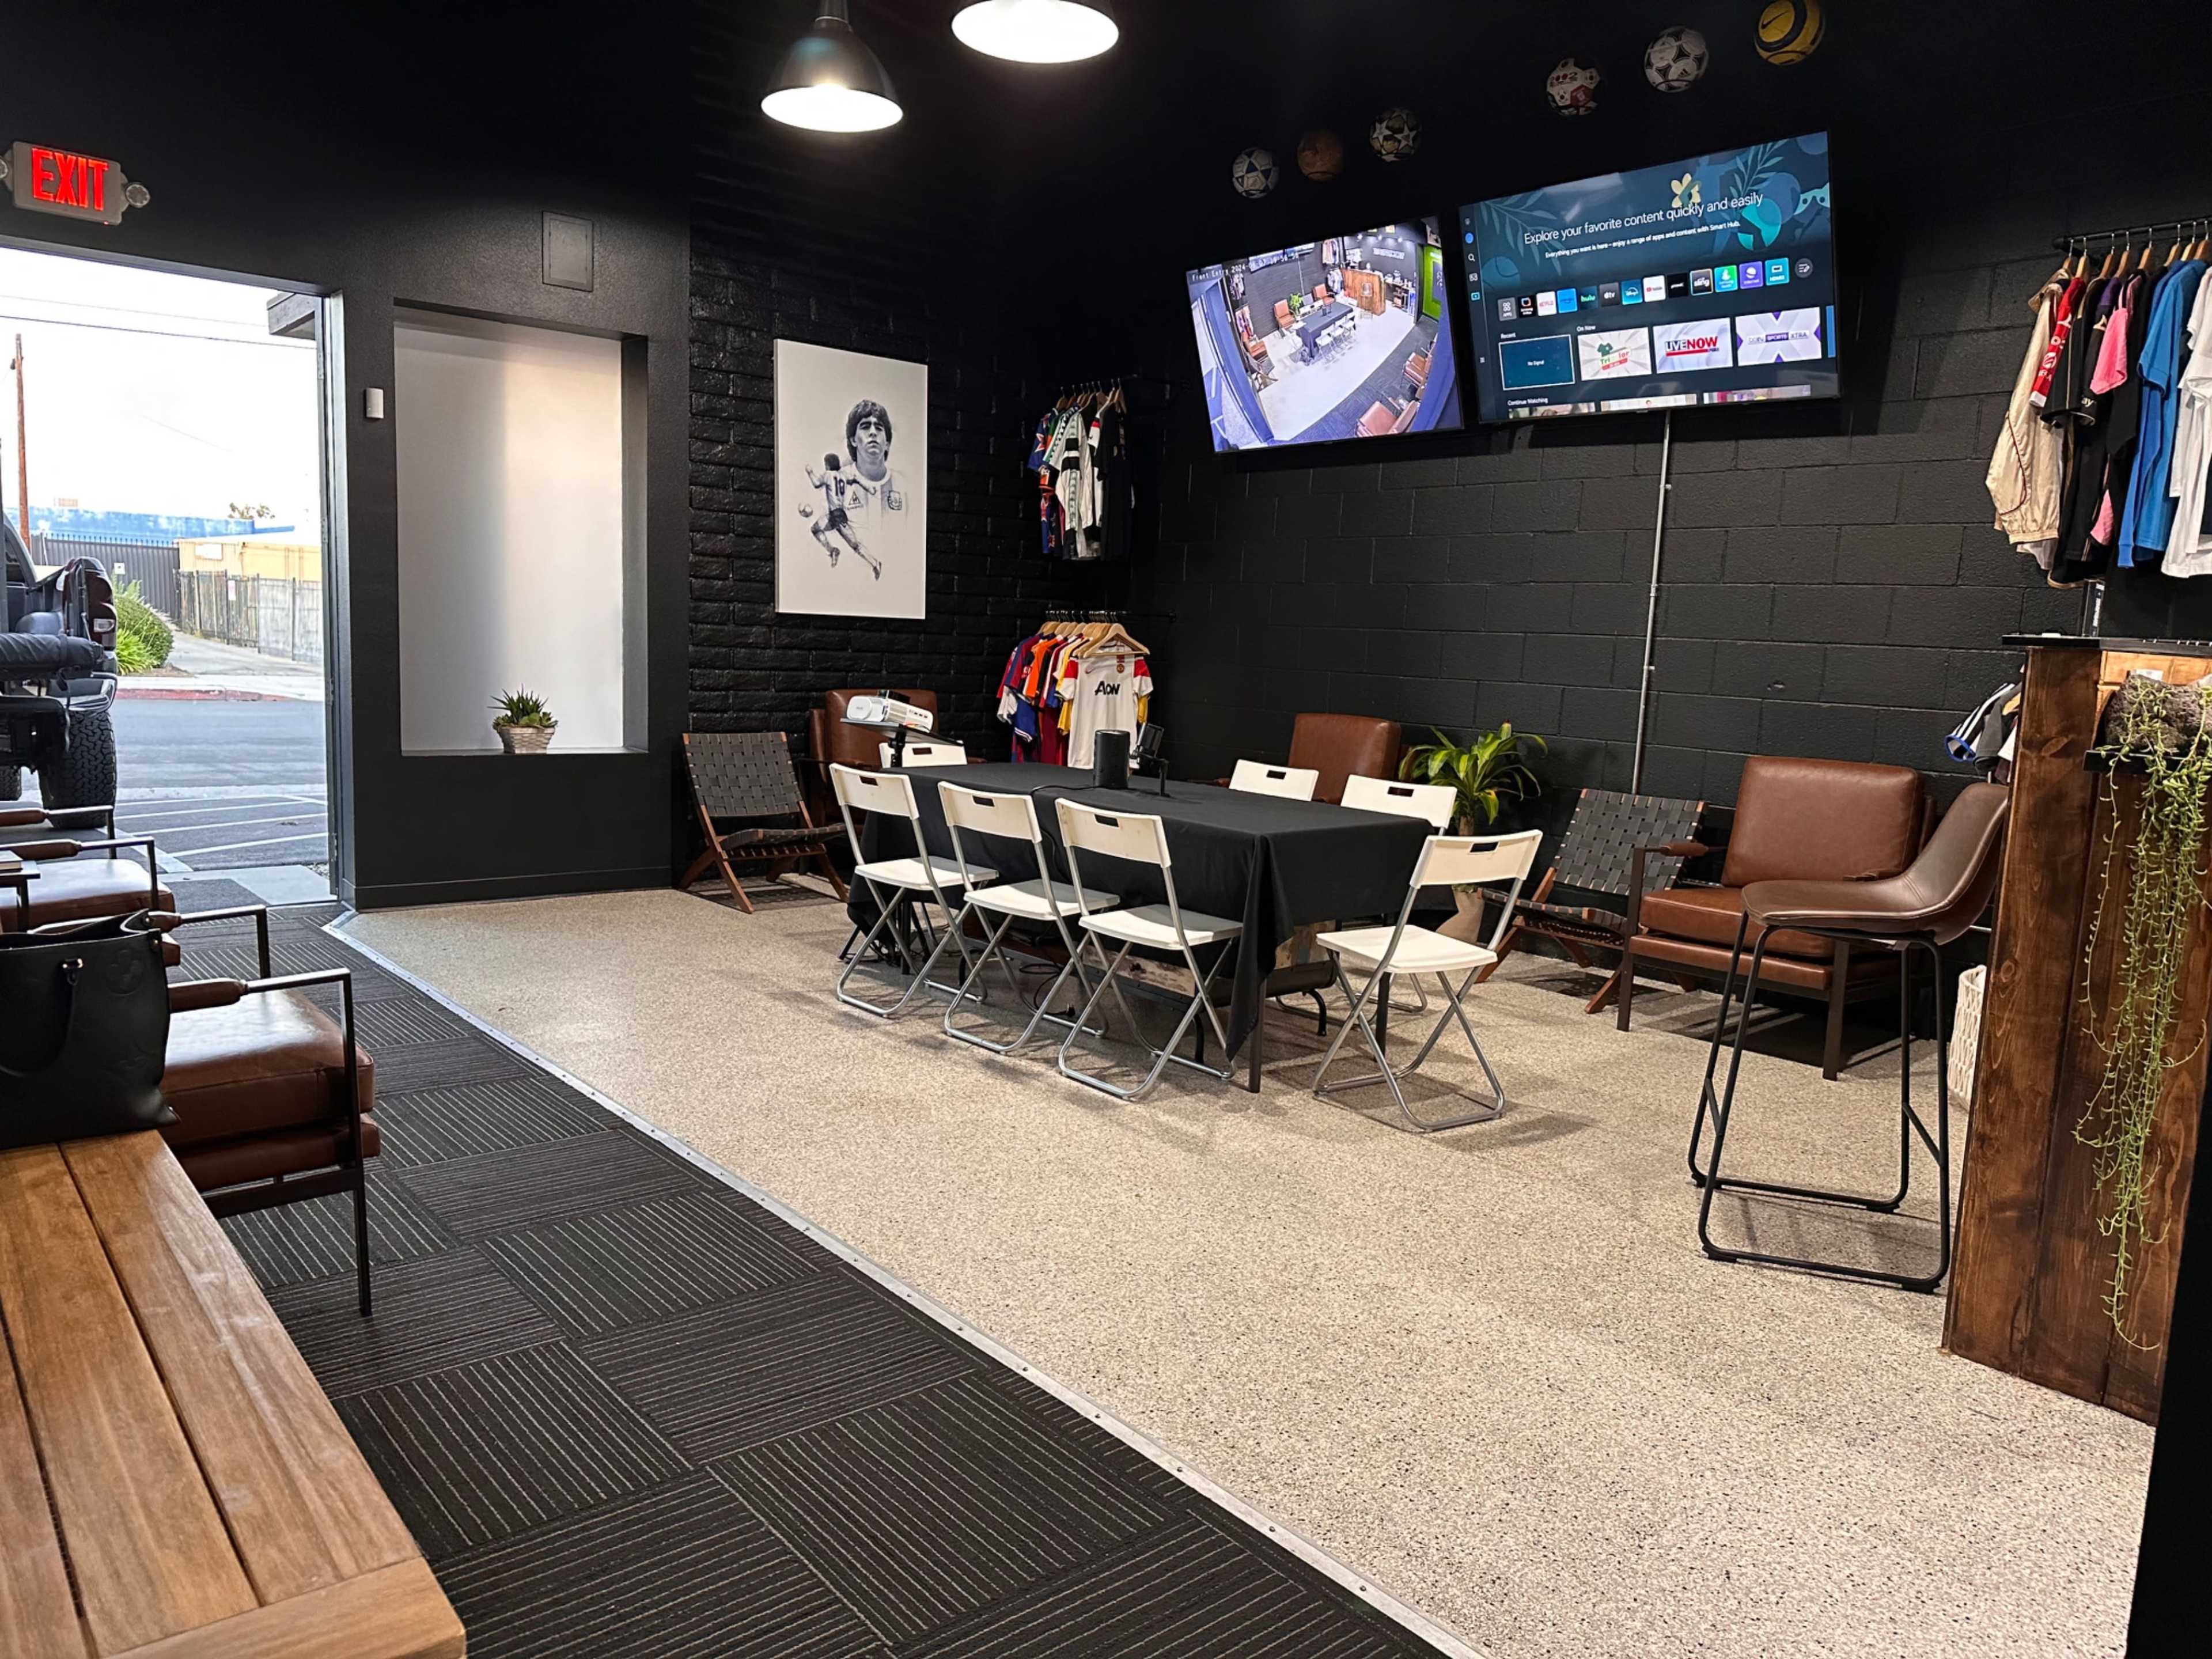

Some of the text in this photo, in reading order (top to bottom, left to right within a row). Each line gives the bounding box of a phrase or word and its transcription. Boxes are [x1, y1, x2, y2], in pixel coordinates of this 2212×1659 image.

[32, 147, 108, 211] EXIT
[1524, 192, 1763, 245] Explore your favorite content quickly and easily
[1545, 248, 1570, 259] Everything
[1646, 233, 1652, 241] of
[1710, 223, 1726, 231] Smart
[834, 476, 845, 496] 10
